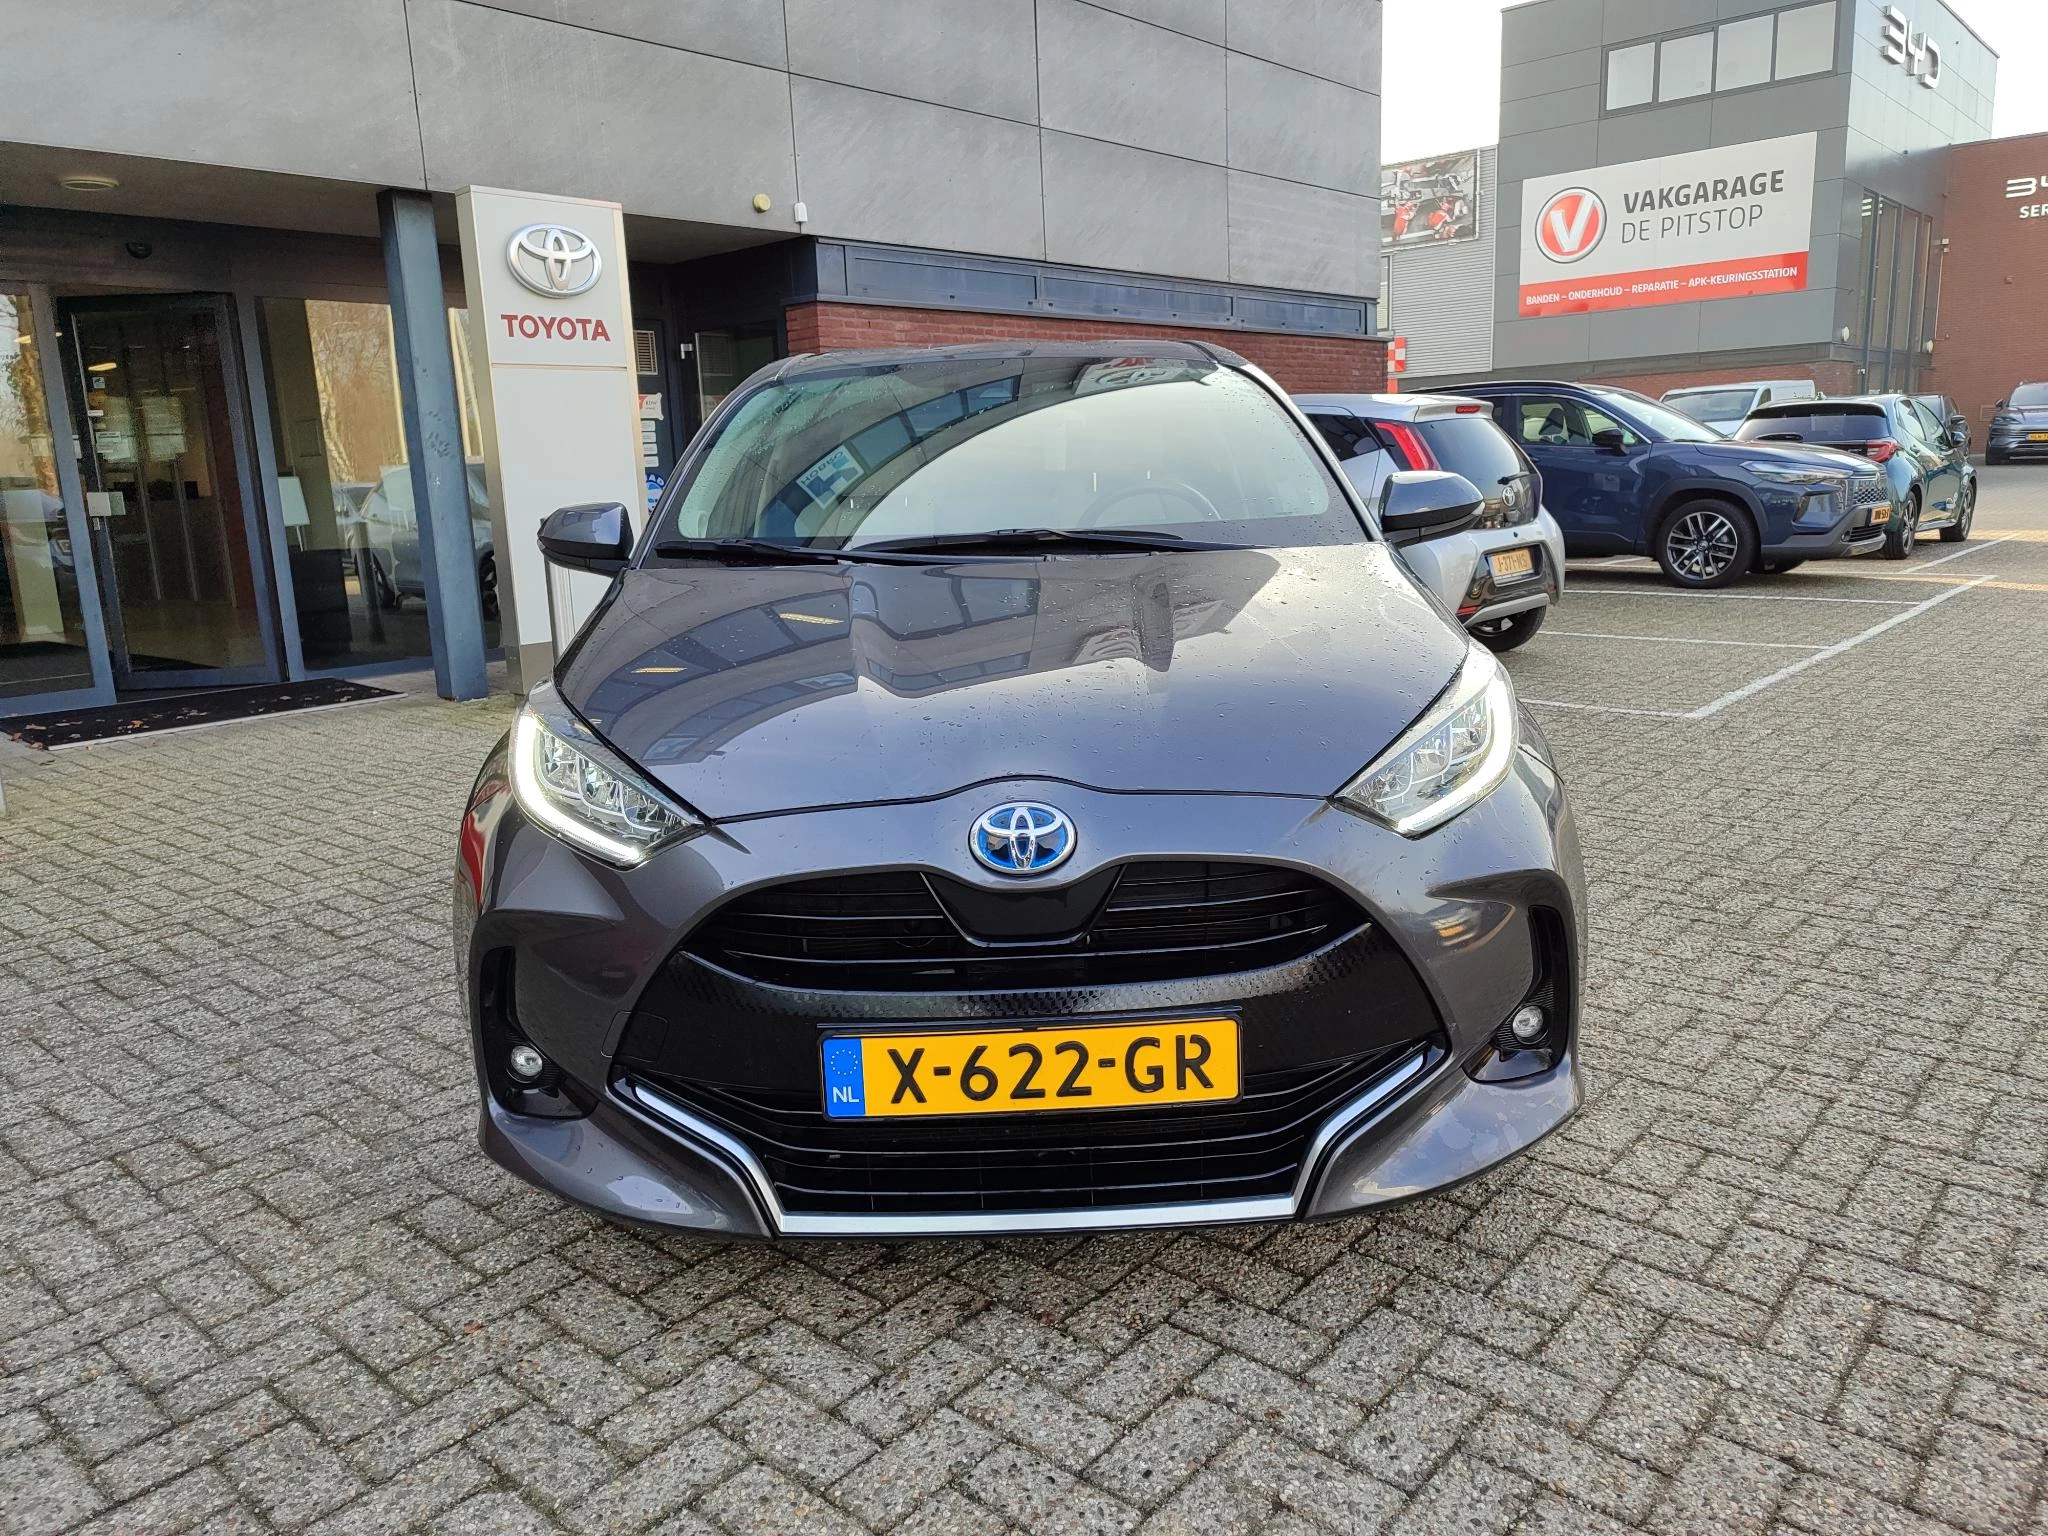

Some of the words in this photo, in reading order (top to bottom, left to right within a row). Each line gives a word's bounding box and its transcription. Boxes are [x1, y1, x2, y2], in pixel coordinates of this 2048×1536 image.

[1881, 5, 1941, 90] BYD
[1623, 169, 1785, 214] VAKGARAGE
[1621, 219, 1650, 244] DE
[1661, 204, 1764, 239] PITSTOP
[1525, 294, 1560, 305] BANDEN
[1568, 286, 1623, 301] ONDERHOUD
[1631, 280, 1680, 294] REPARATIE
[1688, 266, 1798, 288] APK-KEURINGSSTATION
[500, 313, 611, 342] TOYOTA
[887, 1034, 1215, 1105] X-622-GR
[831, 1085, 860, 1105] NL
